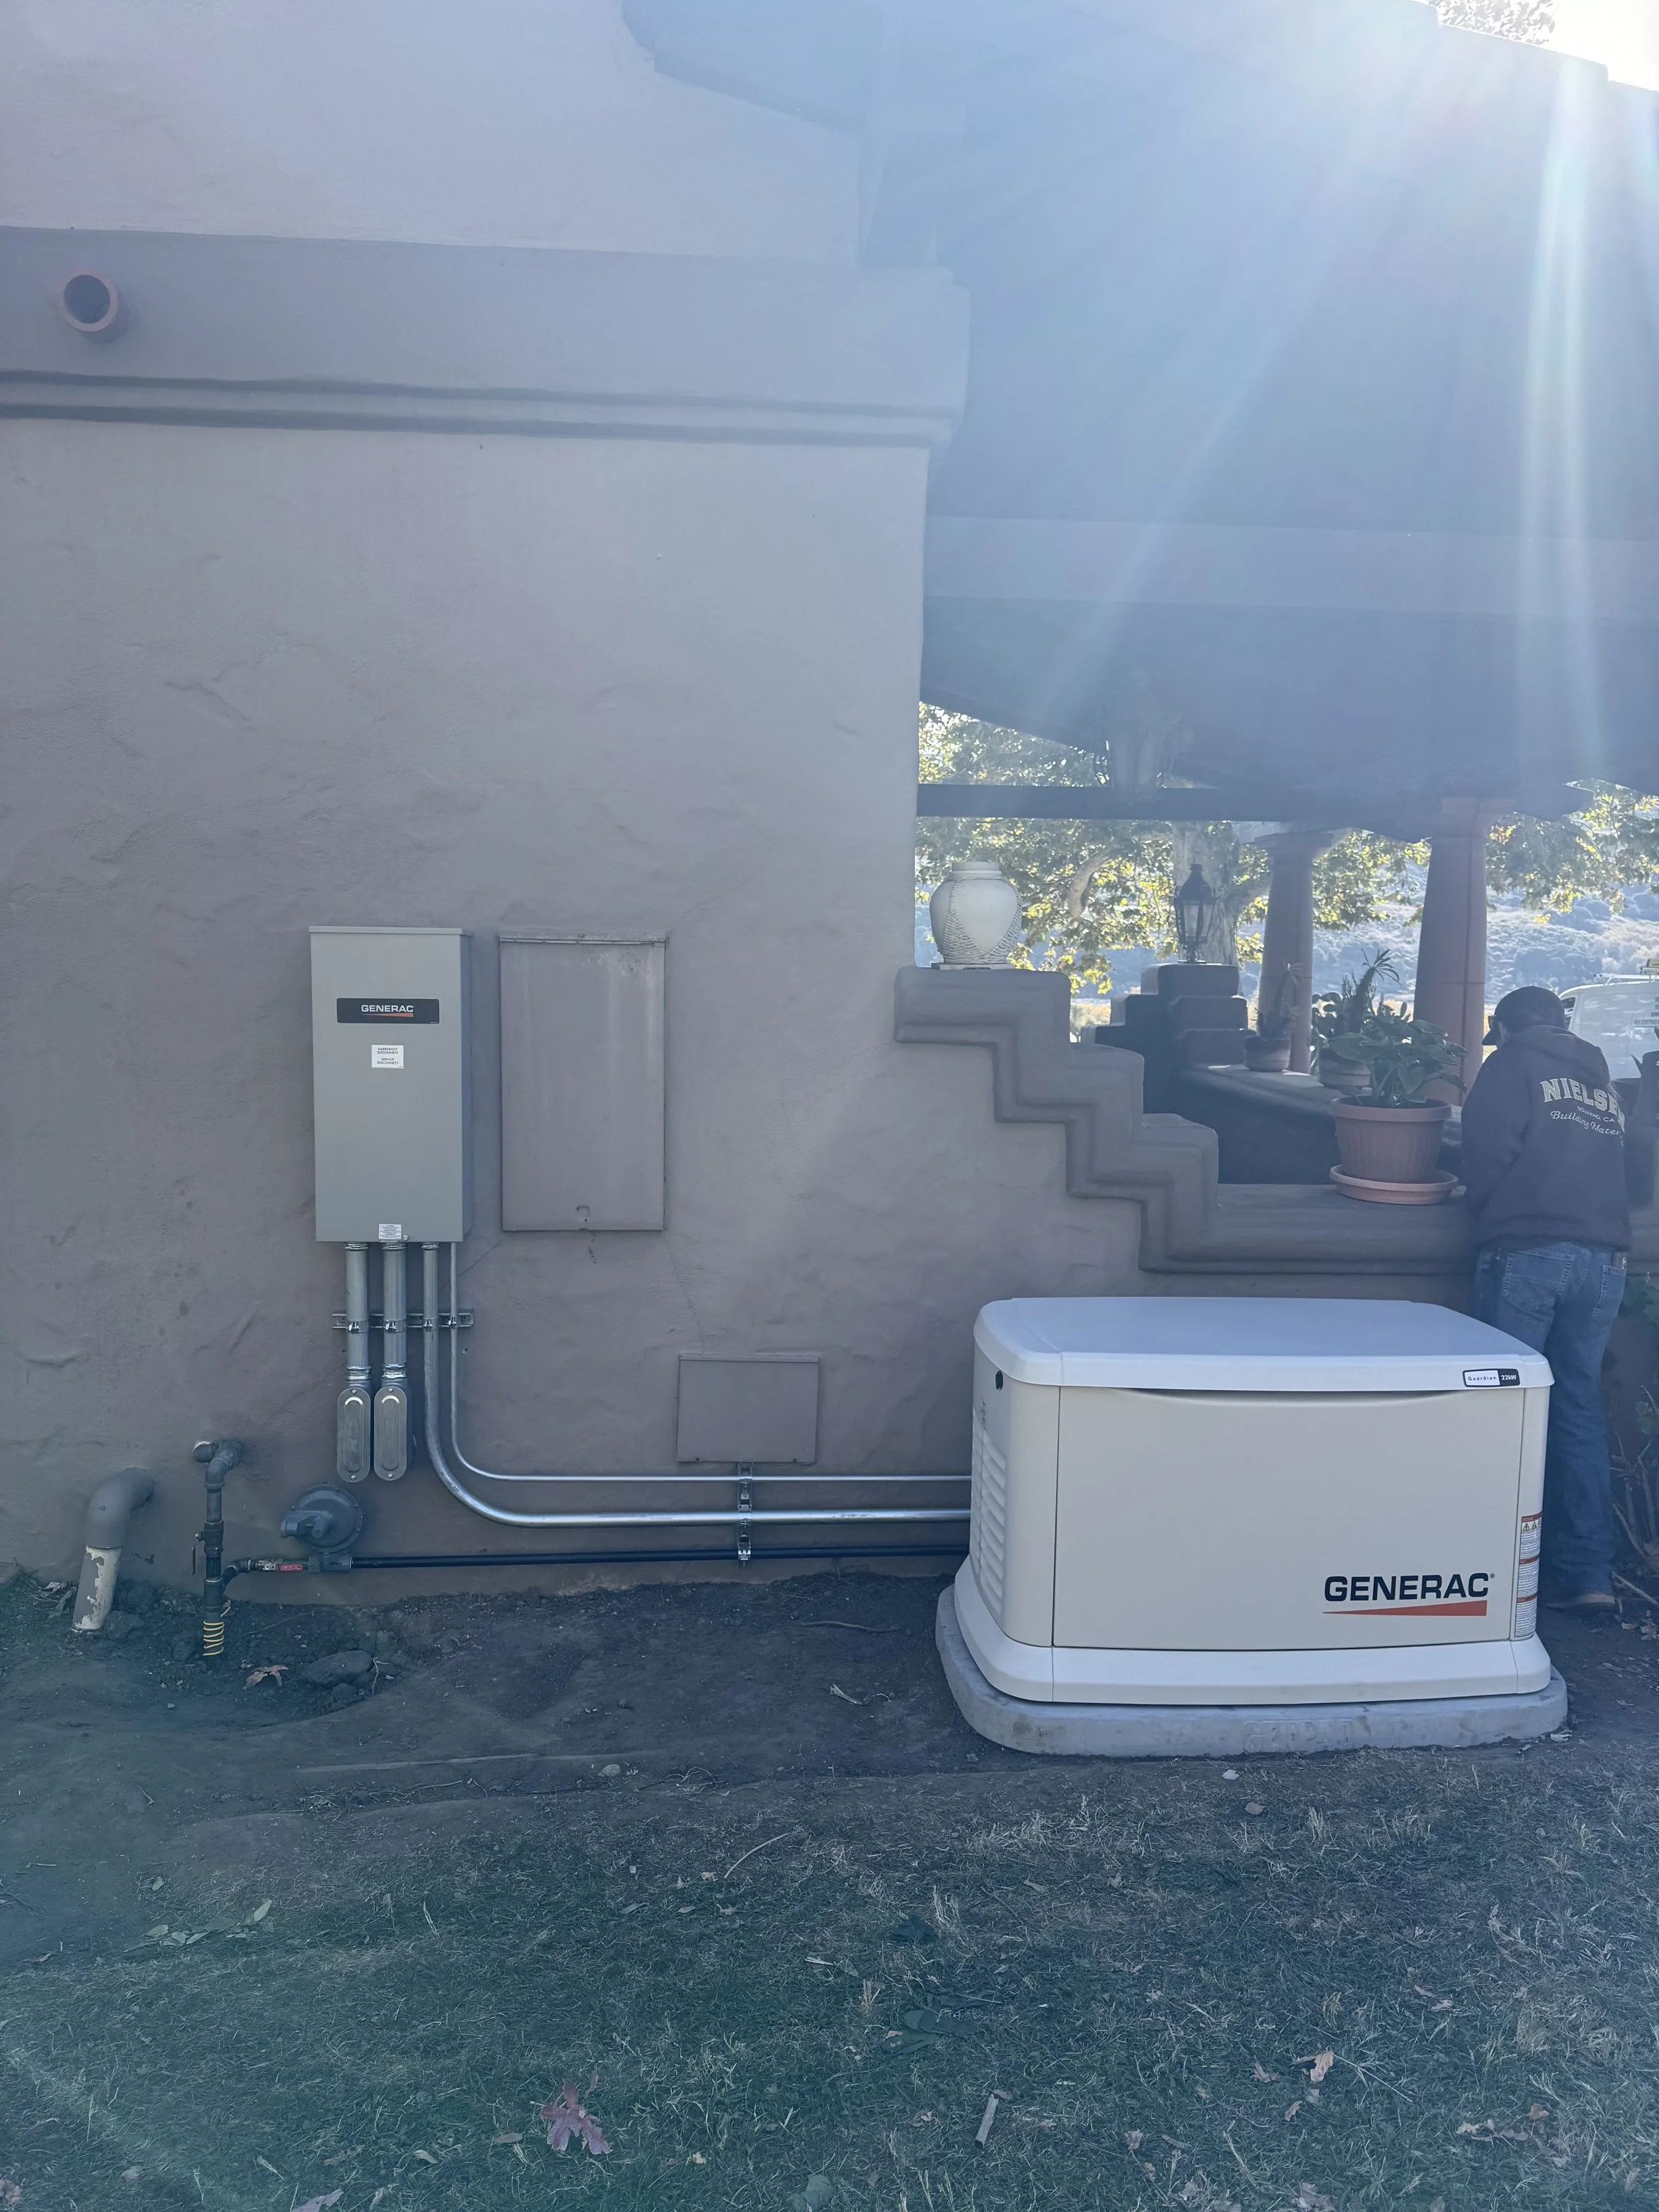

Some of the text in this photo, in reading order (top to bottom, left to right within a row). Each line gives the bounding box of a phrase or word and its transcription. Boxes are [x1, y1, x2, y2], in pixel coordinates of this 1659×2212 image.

[361, 1004, 414, 1013] GENERAC
[1550, 1110, 1589, 1130] Building
[1324, 1572, 1489, 1602] GENERAC
